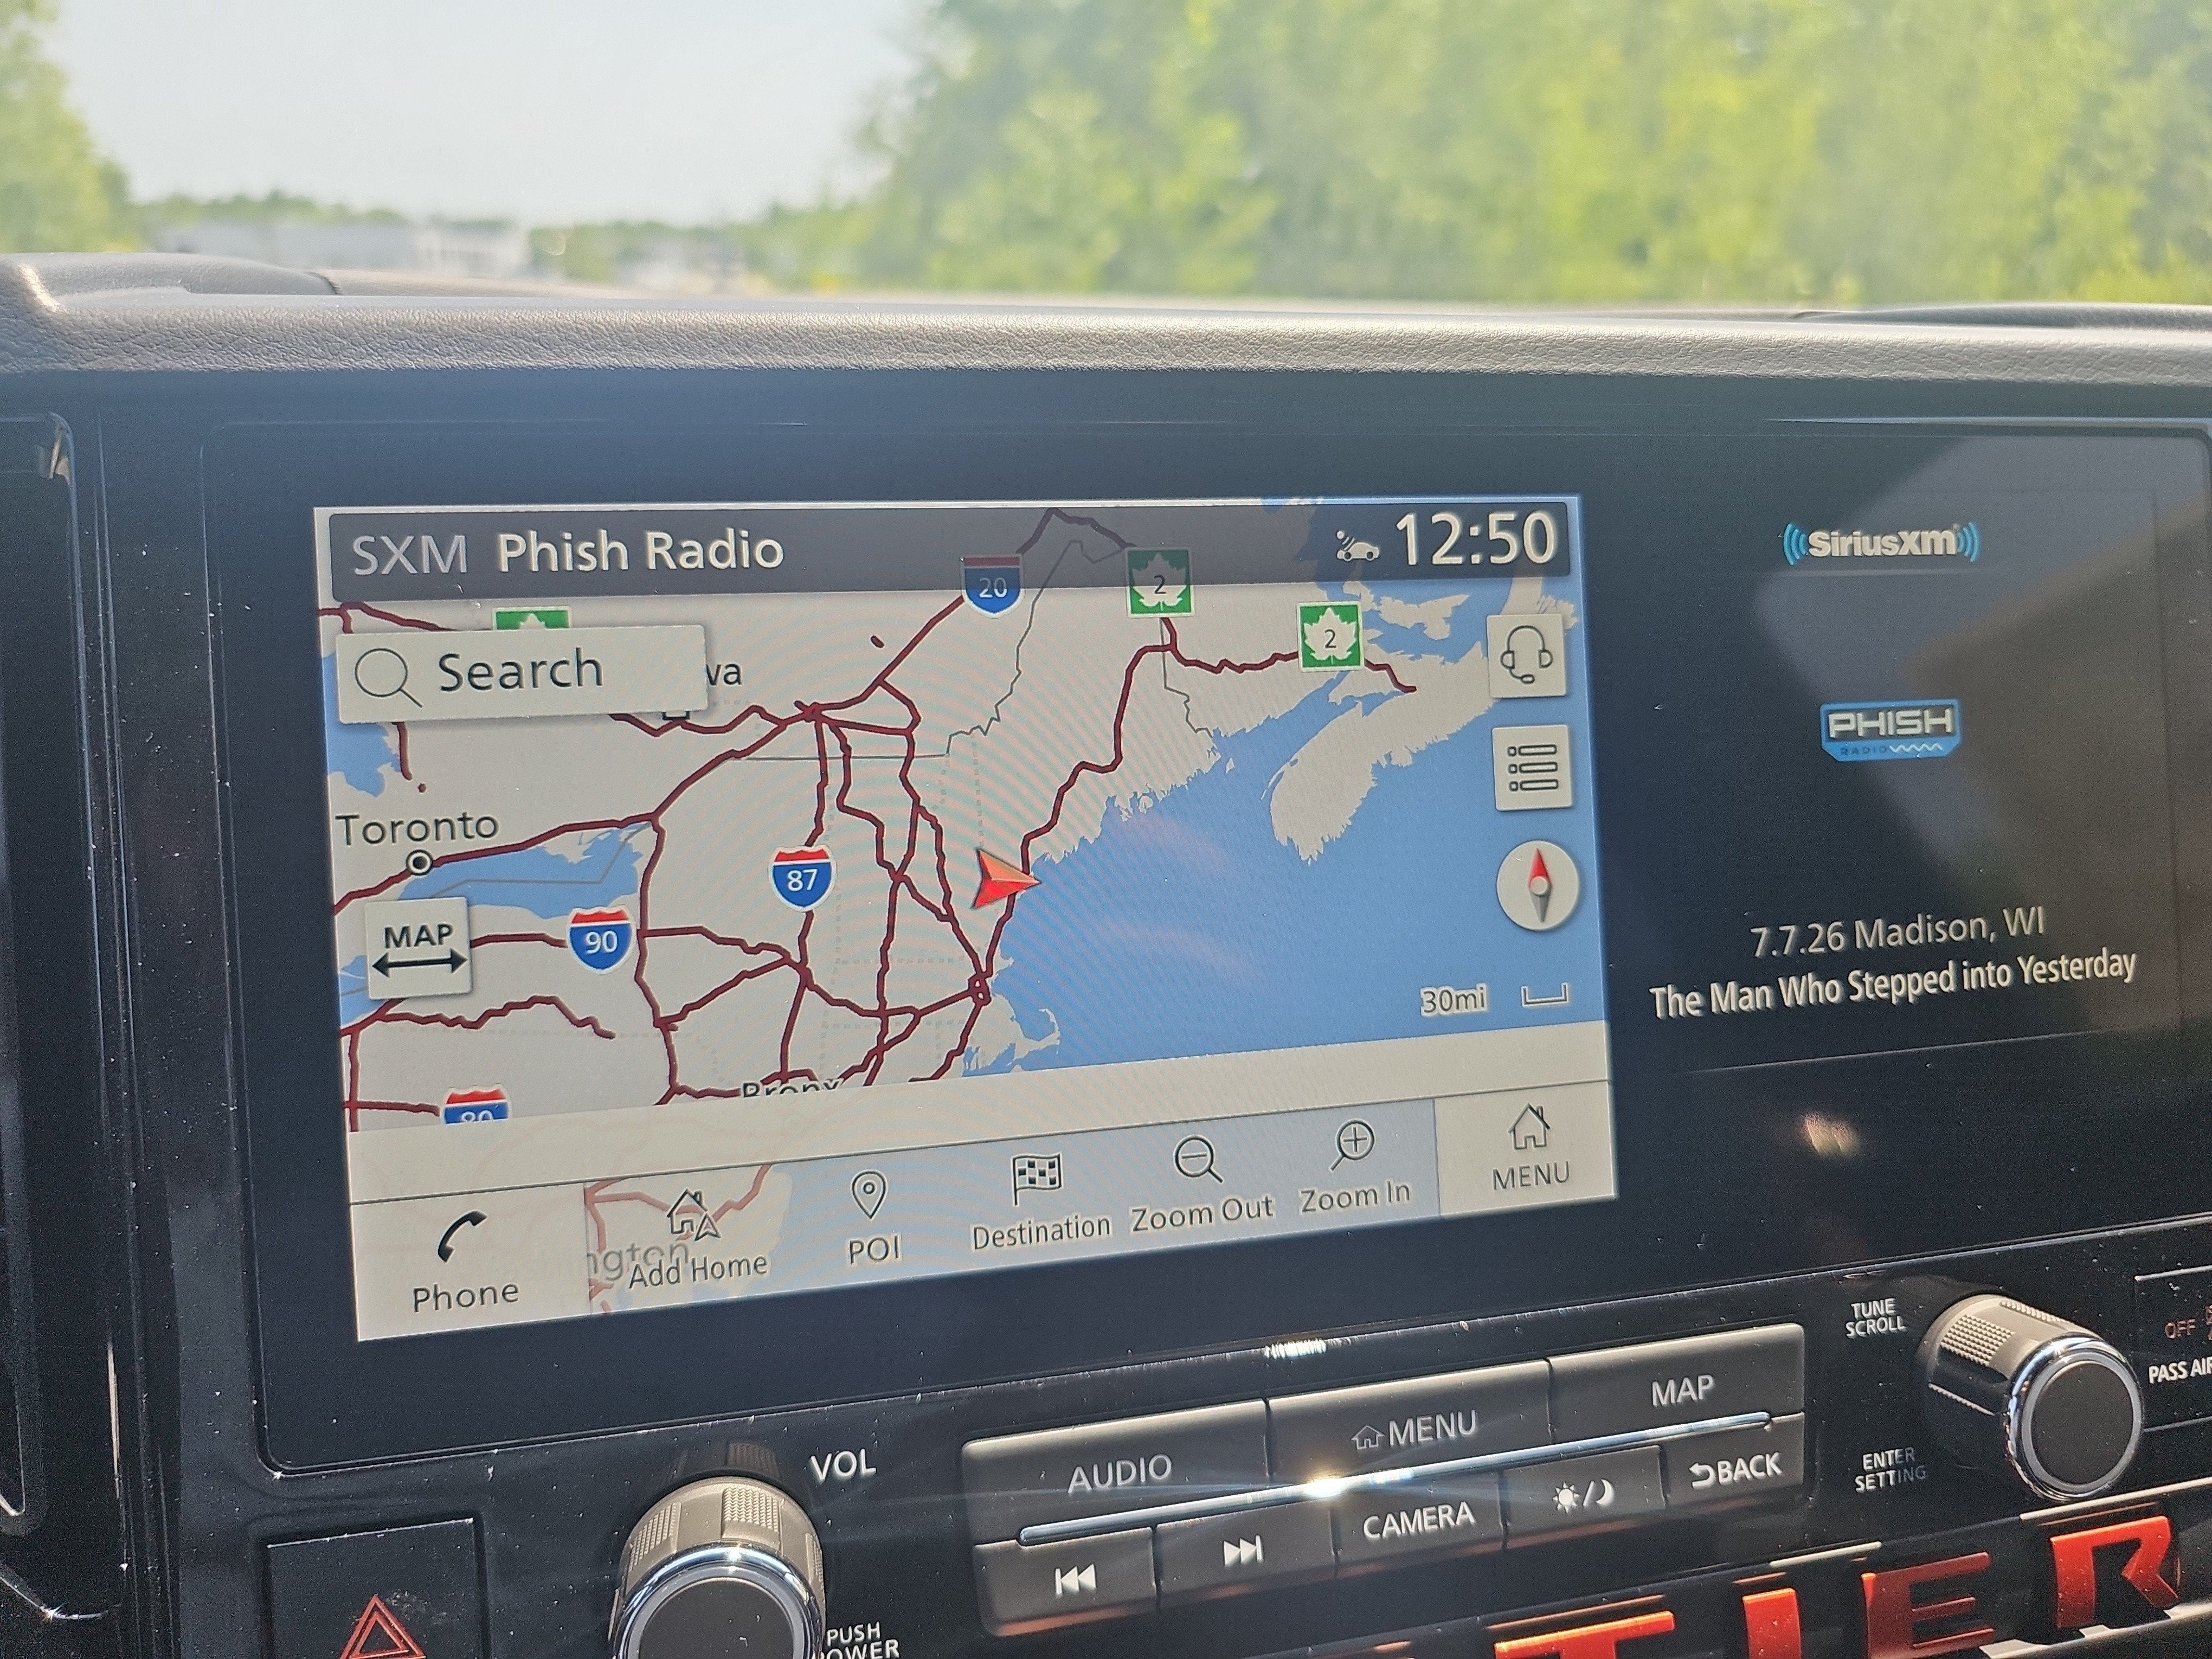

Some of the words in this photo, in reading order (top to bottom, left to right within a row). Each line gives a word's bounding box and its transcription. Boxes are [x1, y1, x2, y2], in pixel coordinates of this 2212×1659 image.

[353, 534, 467, 575] SXM
[498, 529, 629, 573] Phish
[647, 528, 783, 569] Radio
[1396, 511, 1555, 565] 12:50
[979, 577, 1007, 599] 20
[1153, 575, 1166, 595] 2
[1324, 629, 1337, 648] 2
[440, 648, 603, 692] Search
[1828, 708, 1952, 738] PHISH
[1841, 747, 1887, 757] RADIO
[336, 813, 499, 846] Toronto
[787, 869, 819, 892] 87
[384, 923, 453, 949] MAP
[586, 932, 617, 954] 90
[1751, 921, 1844, 959] 7.7.26
[1855, 914, 1996, 950] Madison,
[2003, 905, 2046, 937] WI
[1649, 985, 1703, 1019] The
[1710, 980, 1772, 1014] Man
[1779, 972, 1841, 1008] Who
[1849, 961, 1955, 1006] Stepped
[1962, 957, 2011, 990] into
[2017, 946, 2137, 985] Yesterday
[1422, 985, 1485, 1014] 30mi
[1493, 1161, 1570, 1192] MENU
[1301, 1186, 1378, 1214] Zoom
[1387, 1180, 1411, 1206] In
[1133, 1205, 1214, 1234] Zoom
[1223, 1193, 1274, 1224] Out
[972, 1212, 1111, 1251] Destination
[848, 1235, 901, 1264] POI
[629, 1256, 681, 1289] Add
[692, 1255, 768, 1282] Home
[414, 1280, 519, 1314] Phone
[1851, 1297, 1896, 1318] TUNE
[1845, 1314, 1907, 1339] SCROLL
[2165, 1319, 2196, 1339] OFF
[2149, 1361, 2188, 1384] PASS
[1651, 1375, 1715, 1407] MAP
[1388, 1410, 1478, 1448] MENU
[809, 1448, 877, 1483] VOL
[1716, 1452, 1783, 1483] BACK
[1862, 1446, 1915, 1471] ENTER
[1068, 1454, 1172, 1495] AUDIO
[1854, 1465, 1926, 1493] SETTING
[1364, 1501, 1475, 1541] CAMERA
[821, 1639, 899, 1659] OWER
[827, 1621, 880, 1647] PUSH
